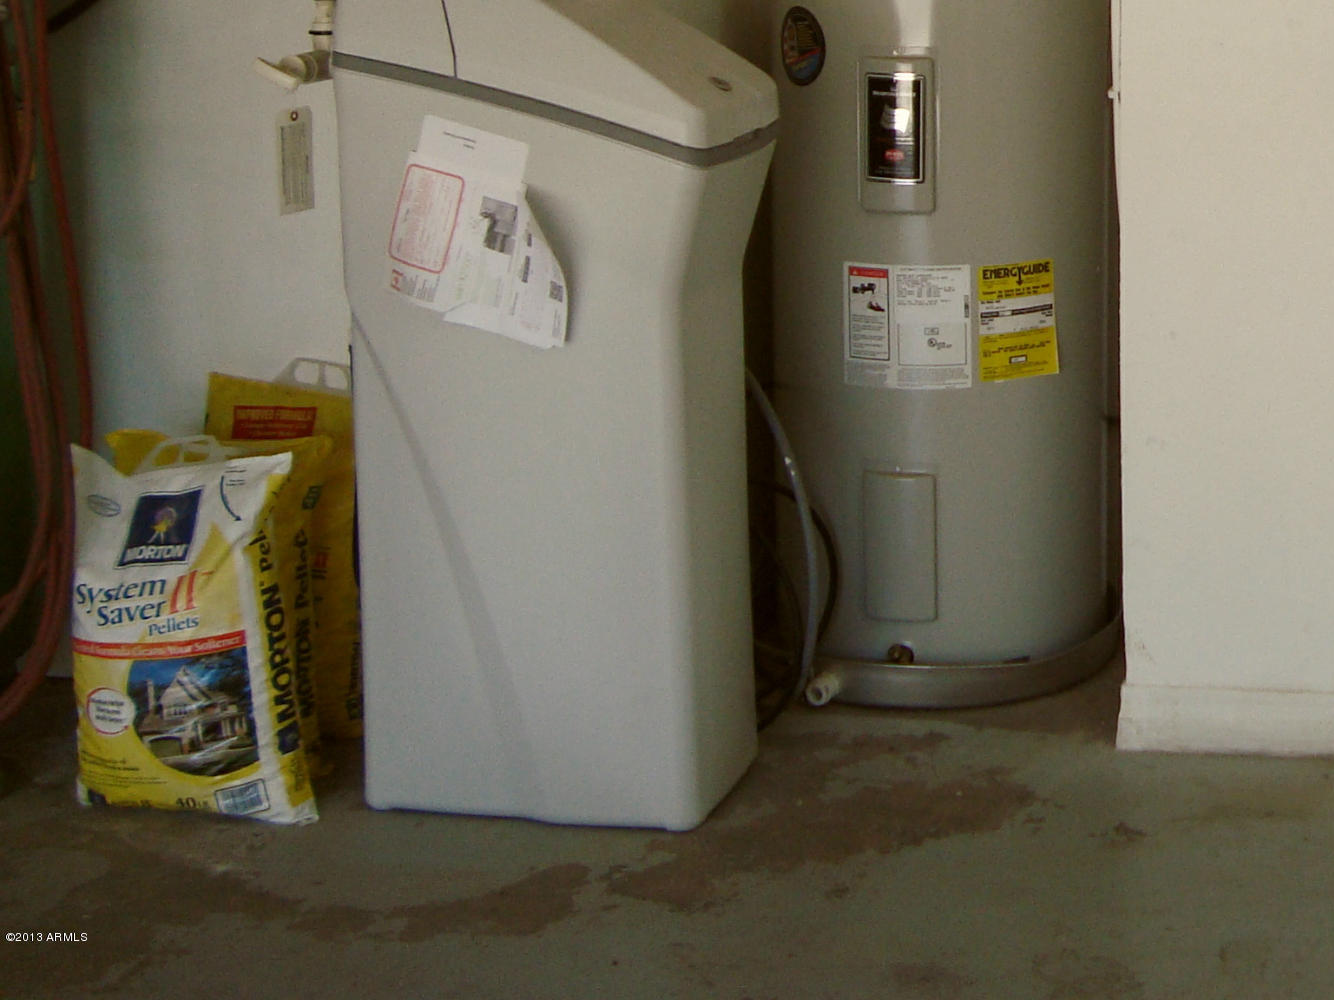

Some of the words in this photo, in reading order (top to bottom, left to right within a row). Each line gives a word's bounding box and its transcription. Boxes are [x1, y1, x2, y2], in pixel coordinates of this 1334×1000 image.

[76, 578, 167, 614] System
[97, 600, 167, 627] Saver
[148, 616, 199, 637] Pellets
[260, 582, 297, 724] MORTON
